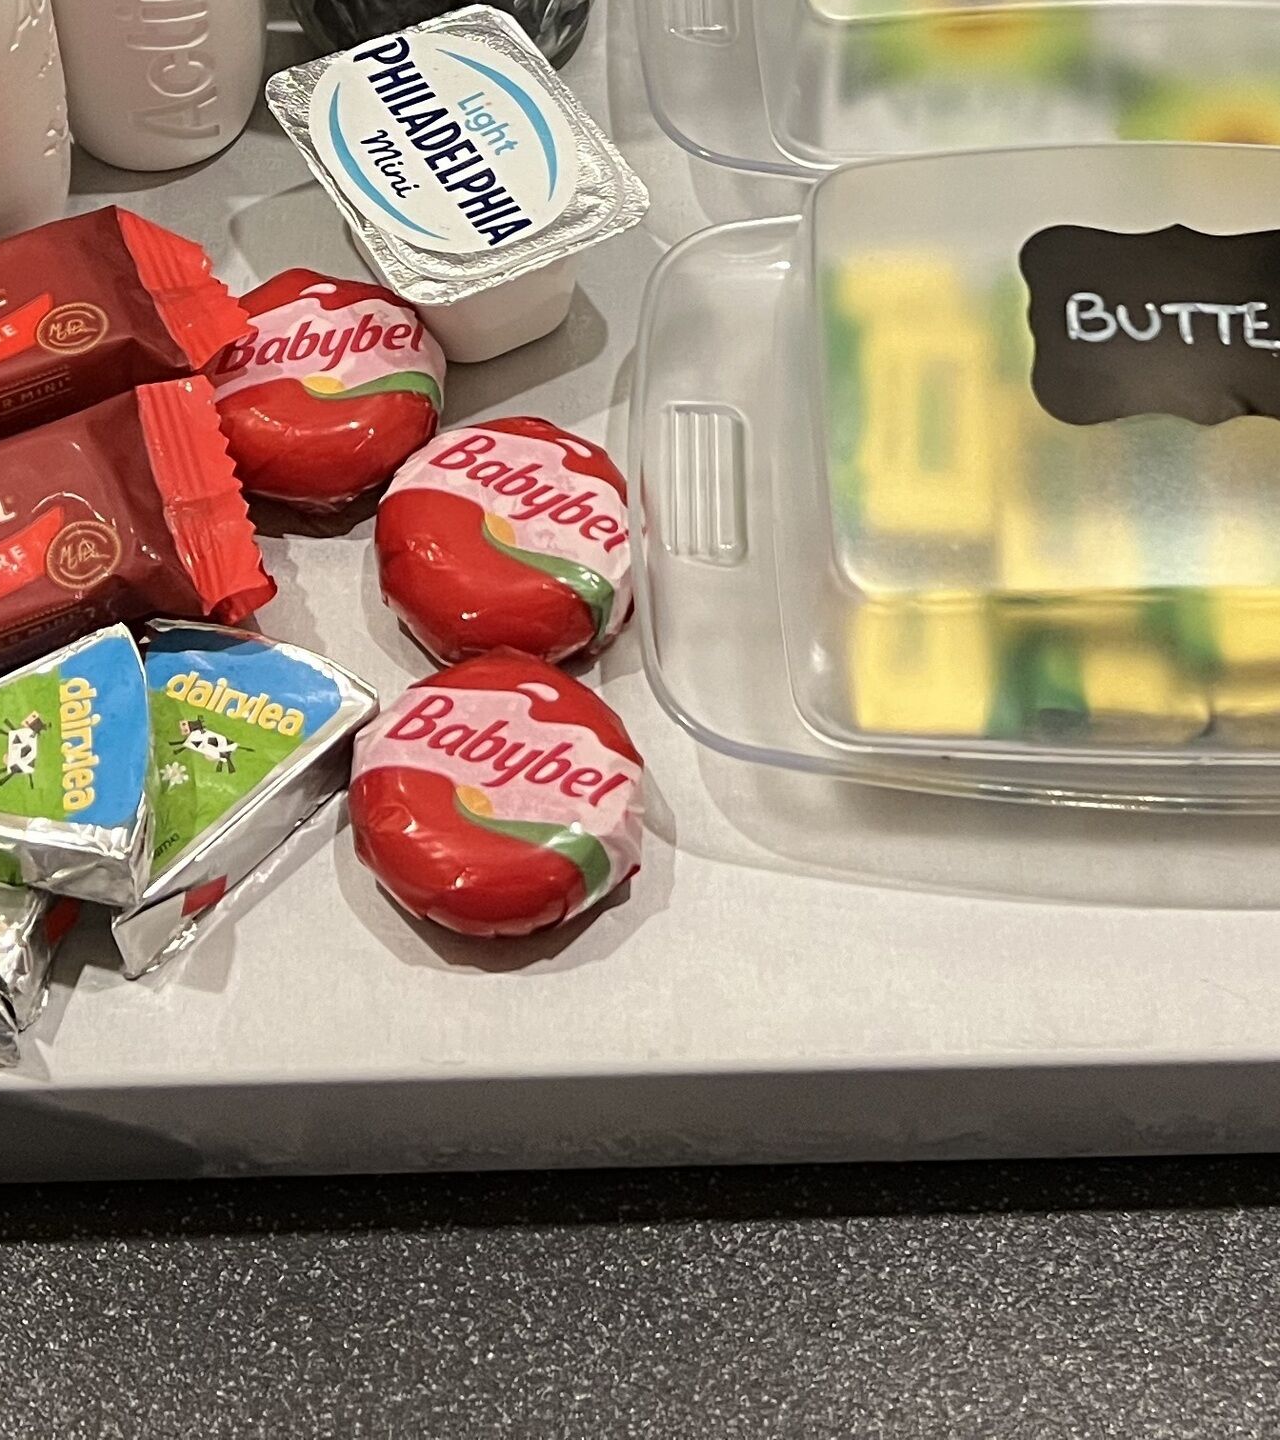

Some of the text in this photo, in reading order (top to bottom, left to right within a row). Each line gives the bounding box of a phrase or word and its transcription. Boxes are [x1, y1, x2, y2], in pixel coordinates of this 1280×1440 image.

[353, 36, 533, 246] PHILADELPHIA
[457, 91, 520, 156] Light
[360, 130, 420, 199] Mini
[214, 314, 423, 375] Babybel
[20, 381, 65, 403] MINI
[428, 434, 630, 553] Babybel
[166, 671, 304, 736] dairylea
[60, 678, 101, 811] dairylea
[385, 694, 629, 807] Babybel
